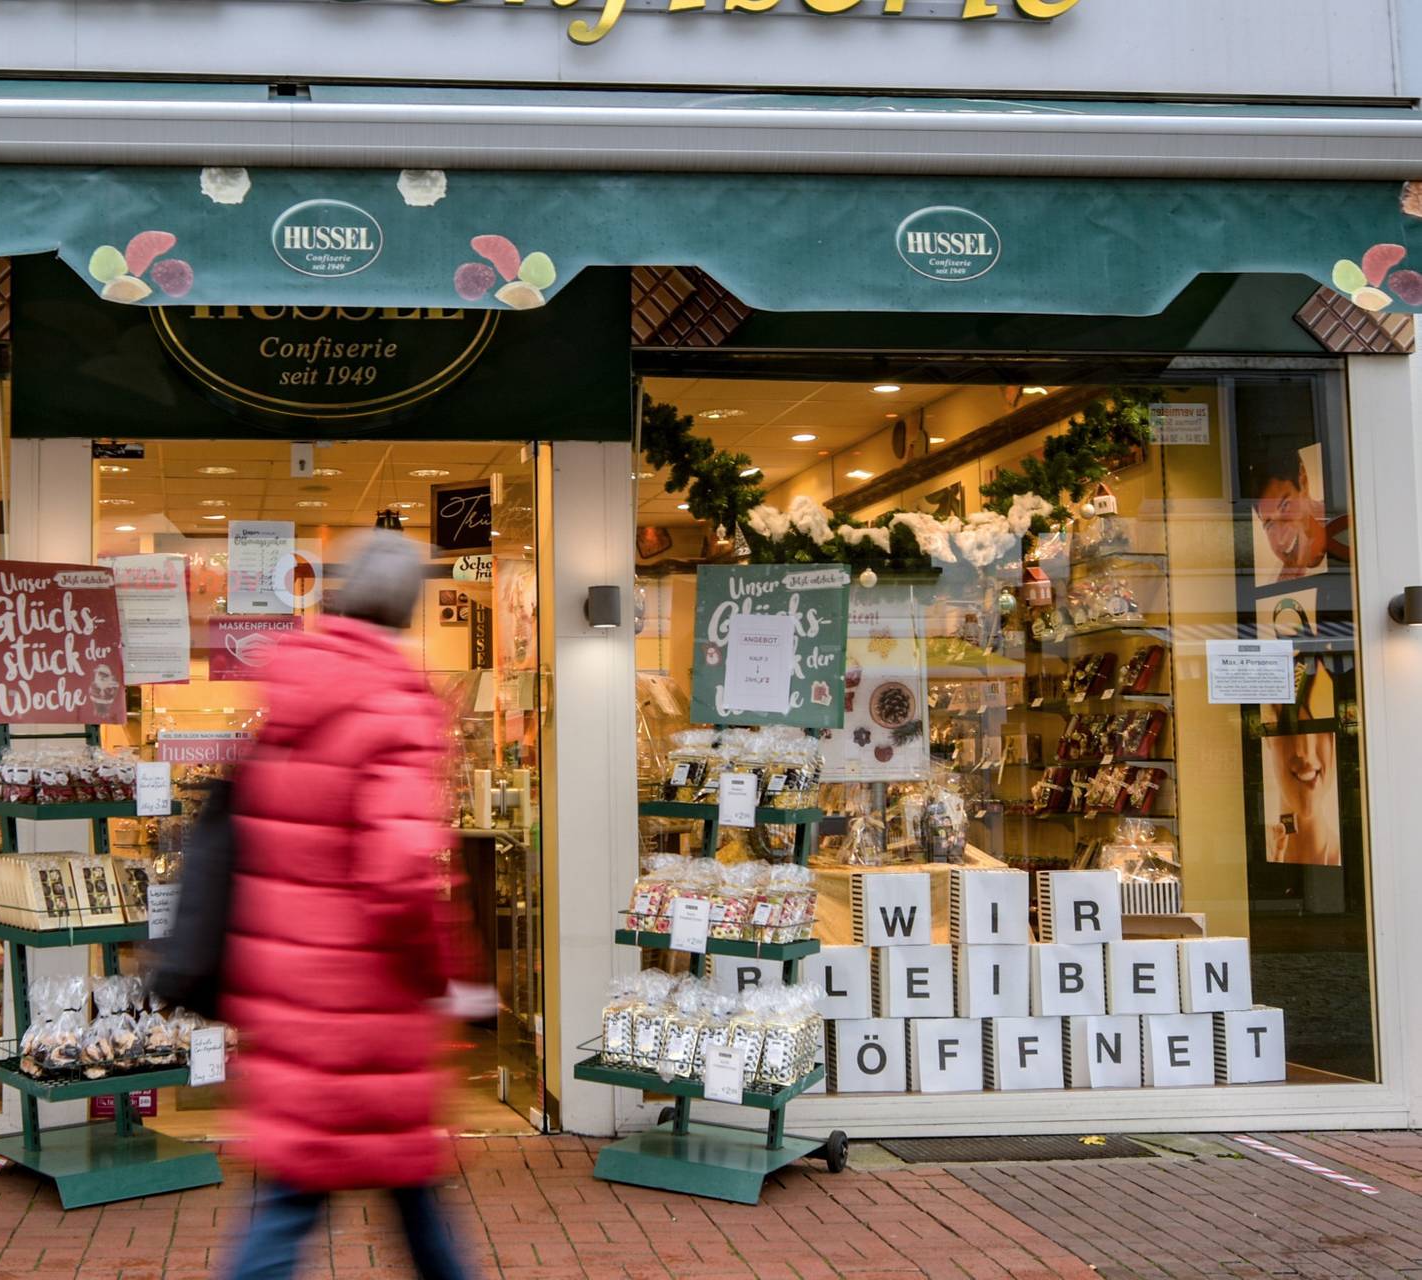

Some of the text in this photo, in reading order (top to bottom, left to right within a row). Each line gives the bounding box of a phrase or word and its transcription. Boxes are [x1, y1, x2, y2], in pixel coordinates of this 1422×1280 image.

[283, 226, 374, 250] HUSSEL
[906, 231, 993, 256] HUSSEL
[305, 253, 352, 263] Confiserie
[928, 258, 972, 267] Confiserie
[259, 336, 398, 365] Confiserie
[279, 365, 377, 386] seit 1949
[0, 572, 51, 594] Unser
[729, 575, 781, 599] Unser
[219, 621, 295, 631] MASKENPFLICHT
[707, 592, 833, 648] Gks-
[743, 636, 778, 644] ANGEBOT
[3, 632, 112, 681] stück der
[806, 646, 835, 669] der
[880, 900, 1102, 938] WIR
[857, 1026, 1269, 1075] ÖFFNET
